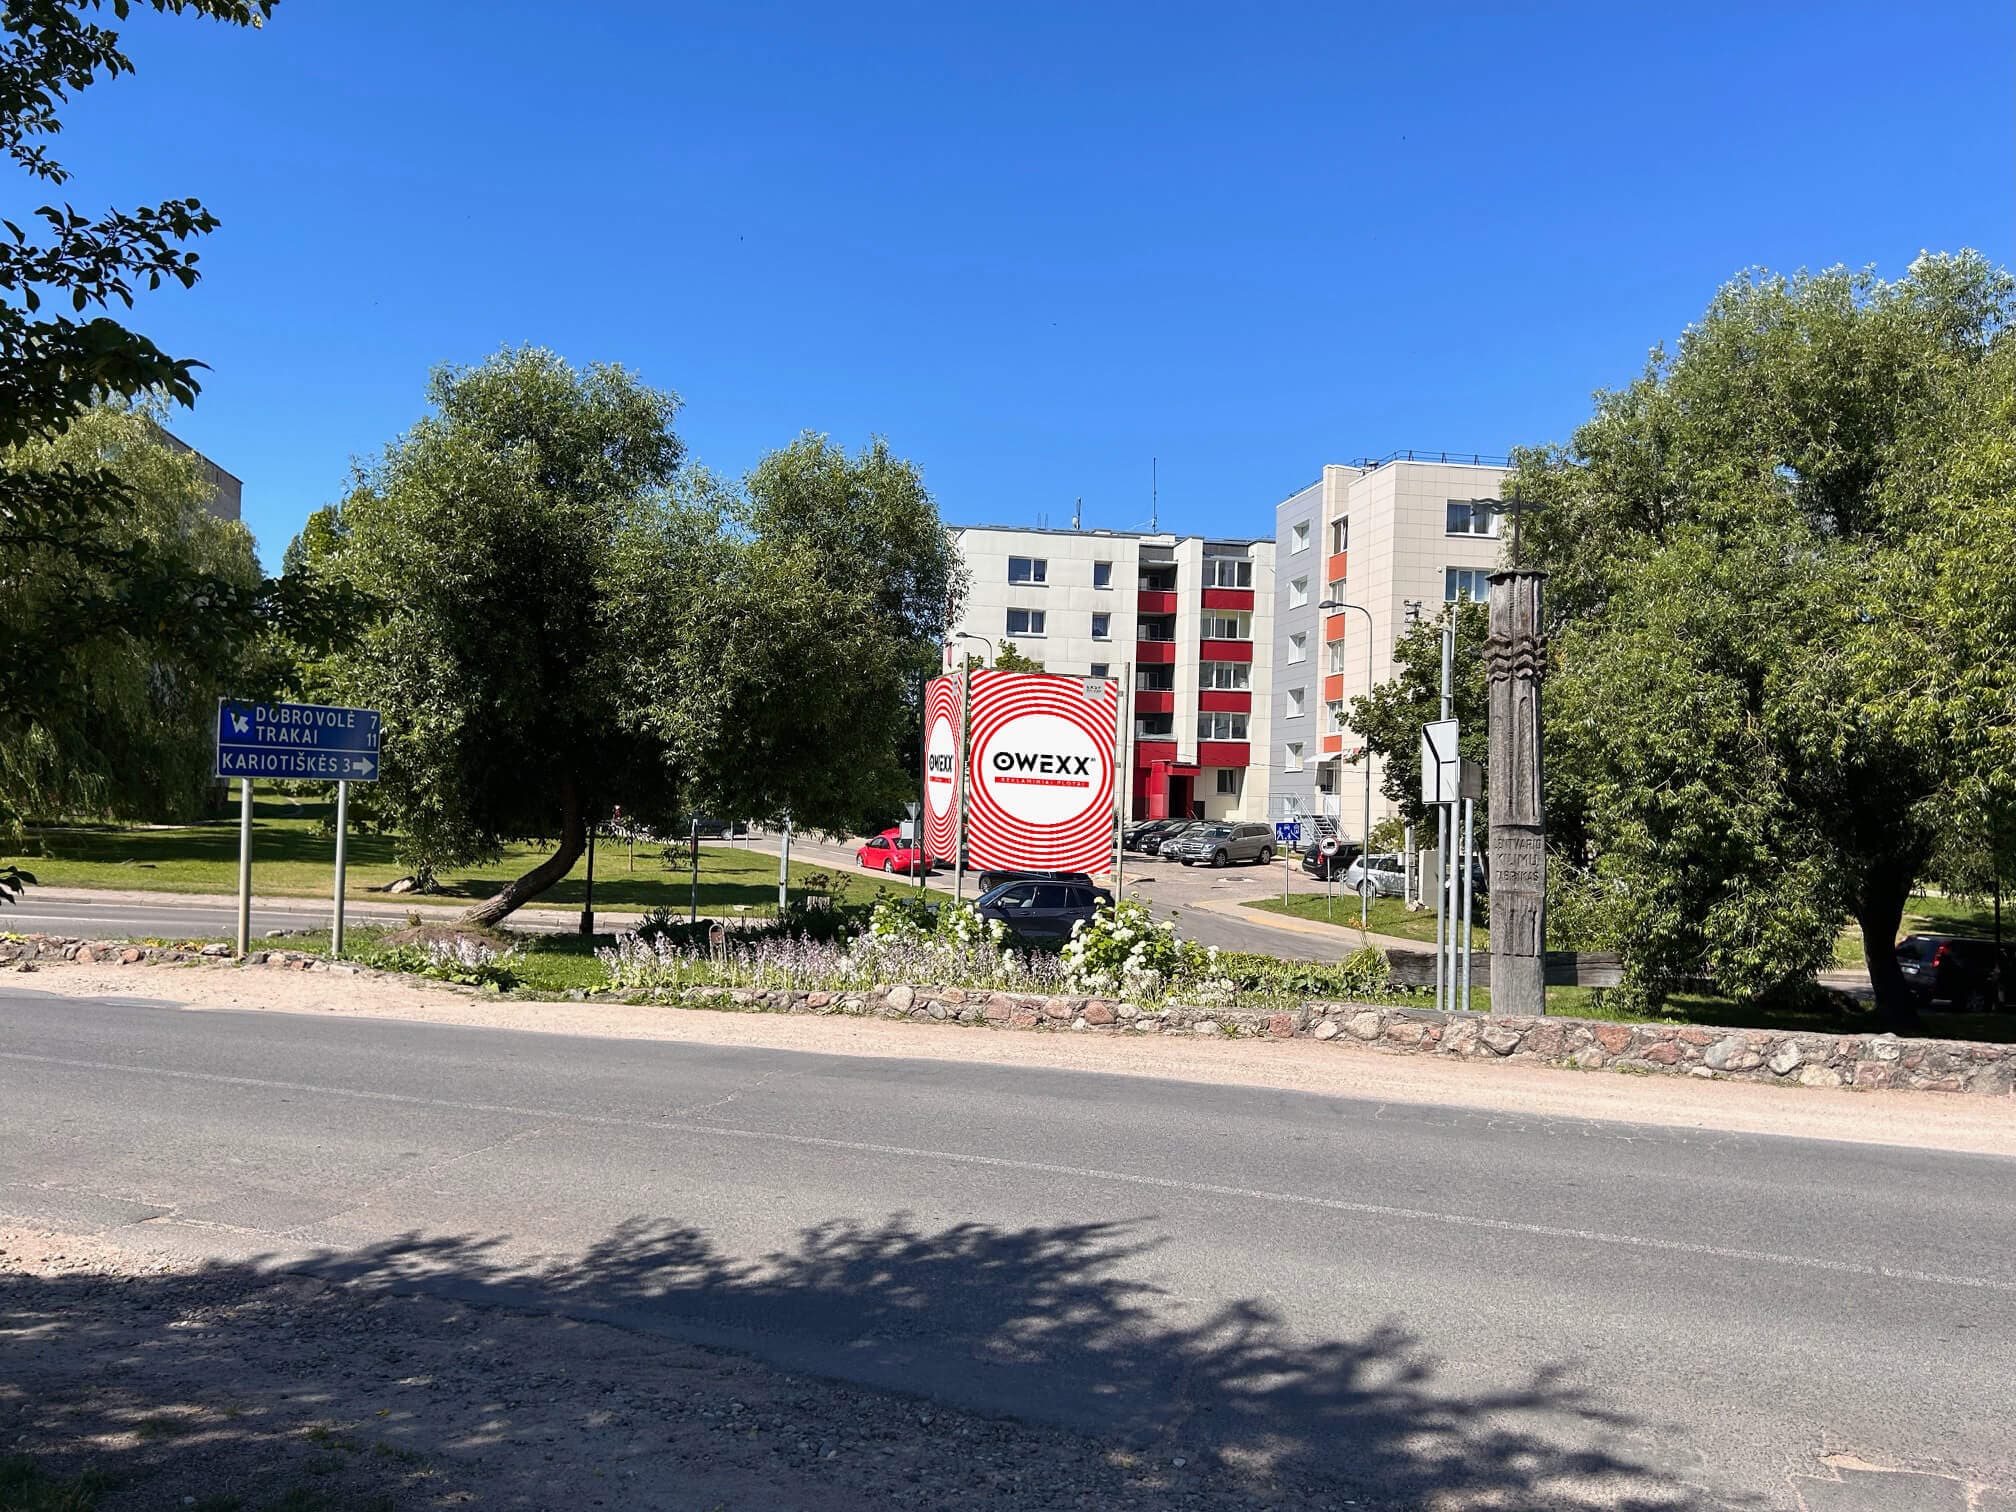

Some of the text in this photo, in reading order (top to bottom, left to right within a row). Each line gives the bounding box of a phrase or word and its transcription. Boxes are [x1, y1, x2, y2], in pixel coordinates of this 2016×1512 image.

[256, 706, 378, 729] DOBROVOLĖ 7
[256, 726, 377, 748] TRAKAI 11
[222, 752, 351, 773] KARIOTIŠKĖS 3
[993, 751, 1090, 775] OWEXX
